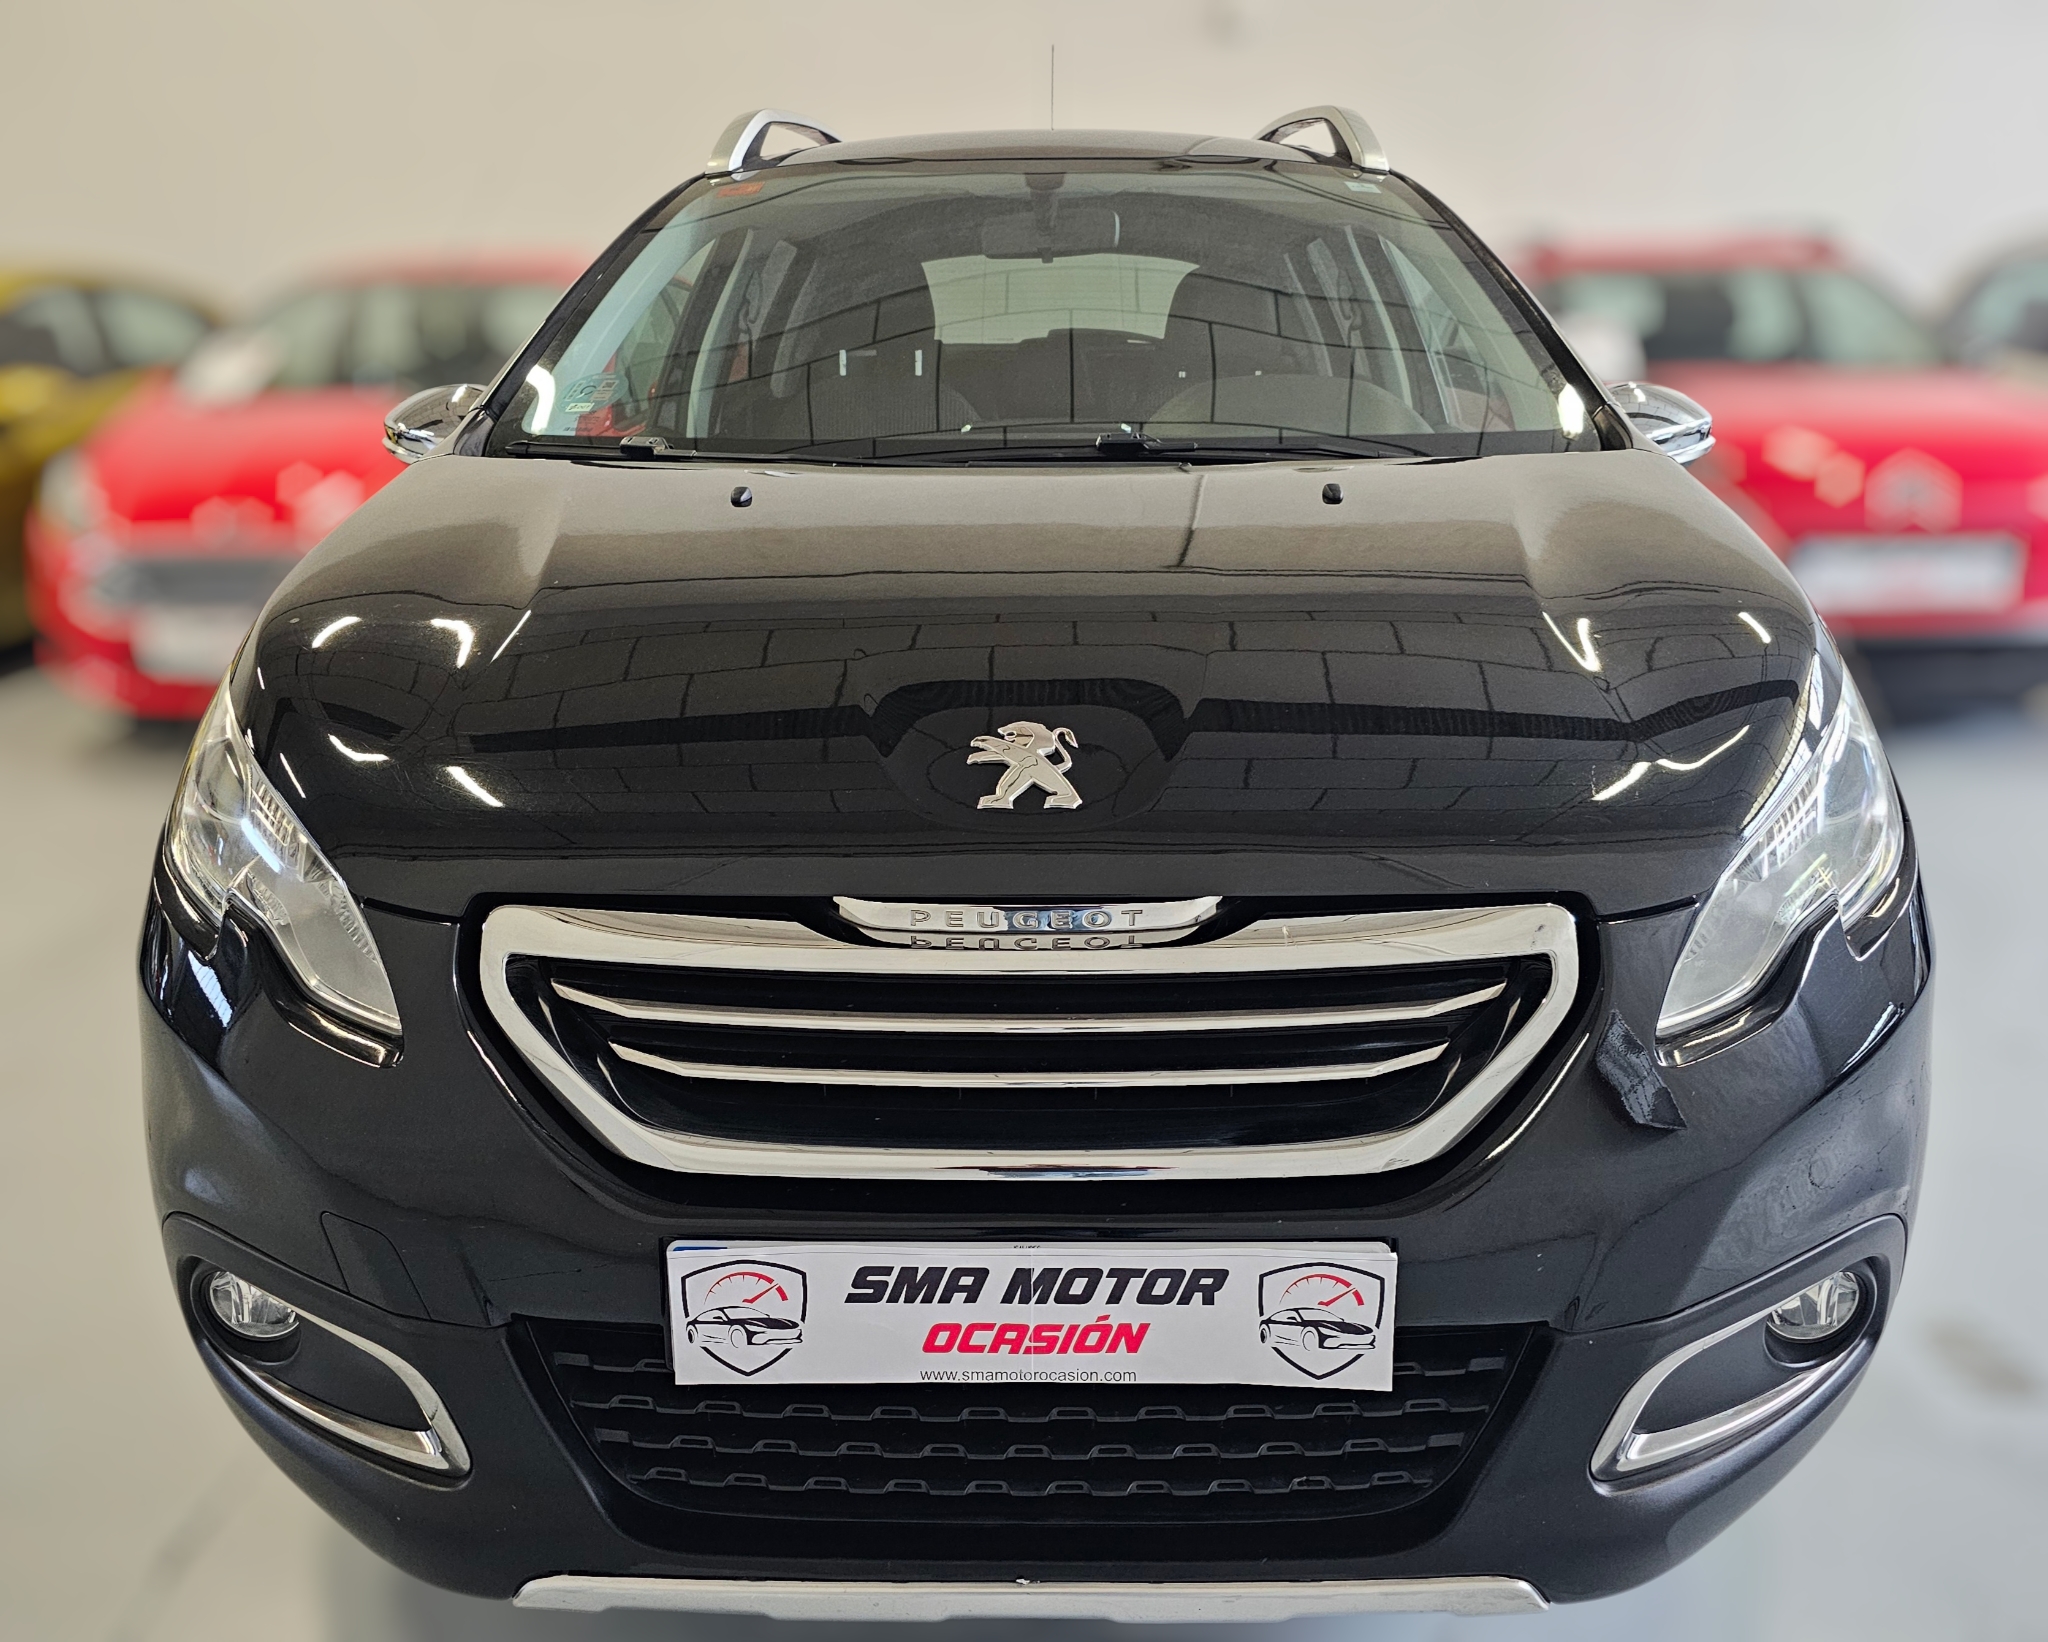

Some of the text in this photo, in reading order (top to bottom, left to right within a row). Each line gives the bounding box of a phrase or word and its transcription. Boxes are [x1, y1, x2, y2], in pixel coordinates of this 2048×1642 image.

[910, 909, 1144, 929] PEUGEOT
[845, 1266, 1230, 1305] SMA MOTOR
[922, 1315, 1151, 1355] OCASIÓN
[919, 1369, 1137, 1383] www.smamotorocasion.com
